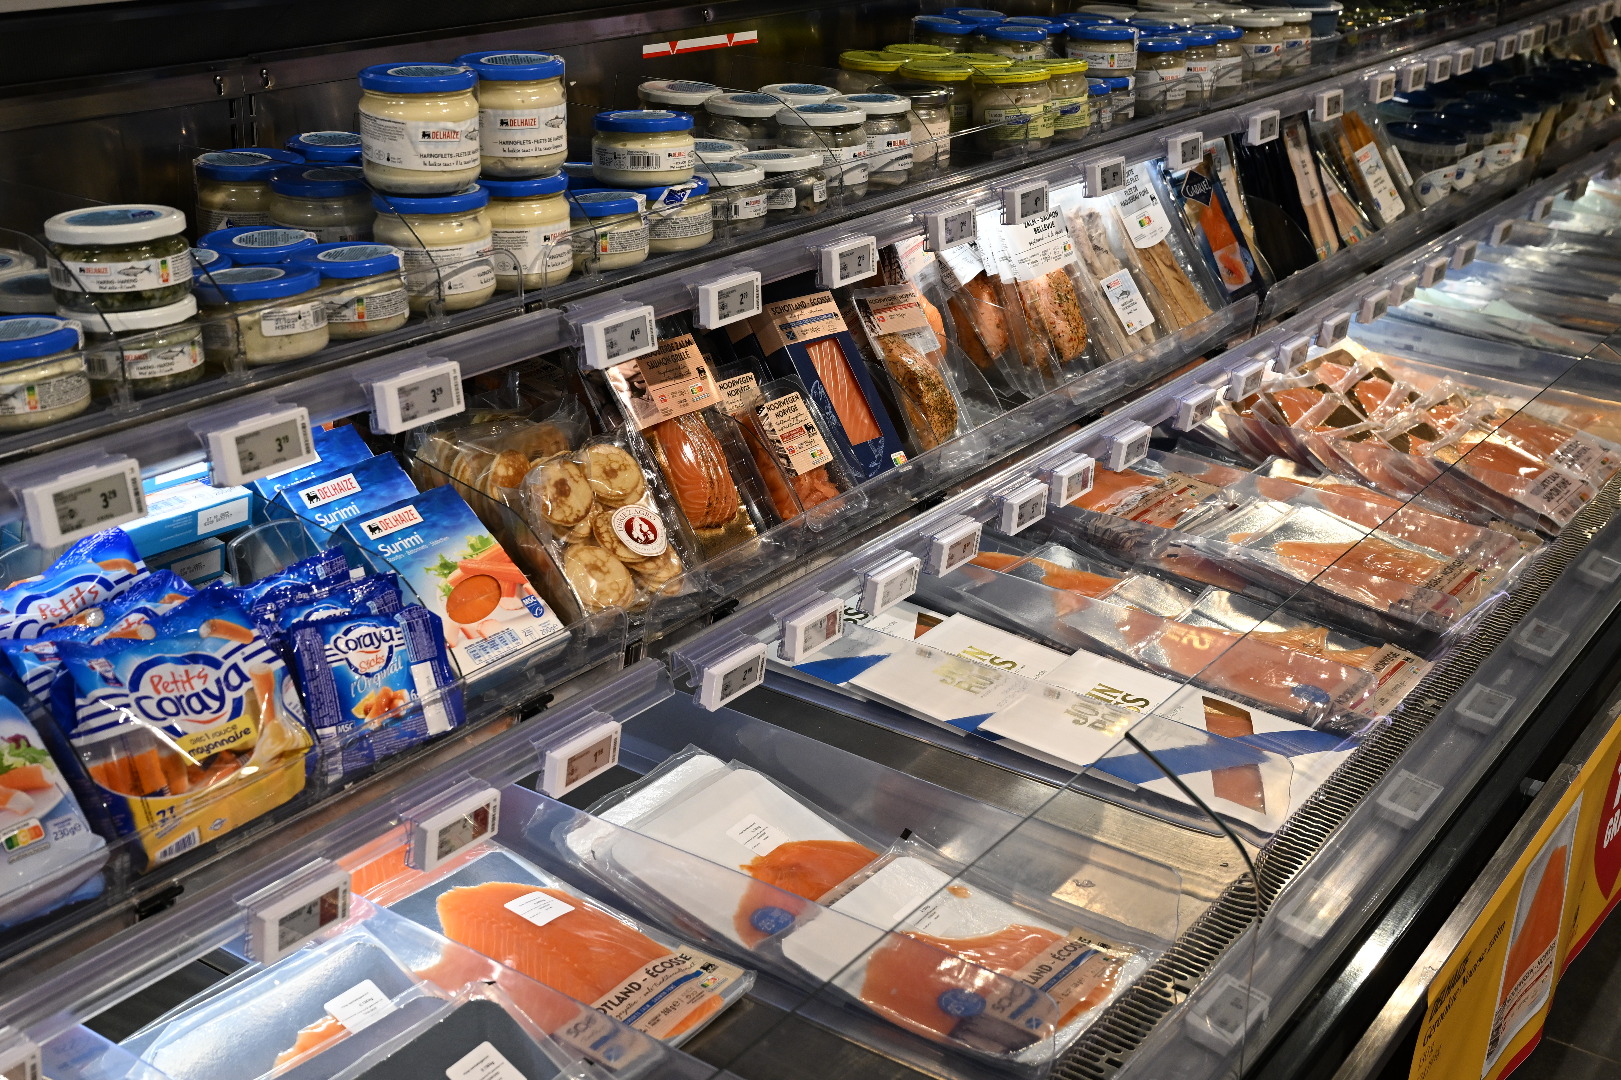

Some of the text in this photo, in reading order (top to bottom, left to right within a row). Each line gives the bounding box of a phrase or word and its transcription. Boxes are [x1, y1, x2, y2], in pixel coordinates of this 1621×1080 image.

[509, 117, 537, 128] DELHAIZE
[431, 130, 460, 140] DELHAIZE
[1186, 180, 1212, 197] GABRIEL
[771, 294, 832, 315] SCHOTLAND ÉCOSSE
[719, 374, 754, 391] NOORWEGEN
[766, 394, 800, 413] NOORWEGEN
[774, 404, 799, 419] NORVÈGE
[317, 477, 357, 500] DELHAIZE
[314, 501, 361, 528] Surimi
[378, 508, 418, 532] DELHAIZE
[377, 531, 424, 558] Surimi
[37, 584, 100, 621] Petits
[522, 595, 537, 606] MSC
[334, 627, 395, 650] Coraya
[134, 656, 252, 722] Coraya
[150, 667, 210, 696] Petits
[187, 726, 252, 758] mayonnaise
[646, 952, 693, 979] ÉCOSSE
